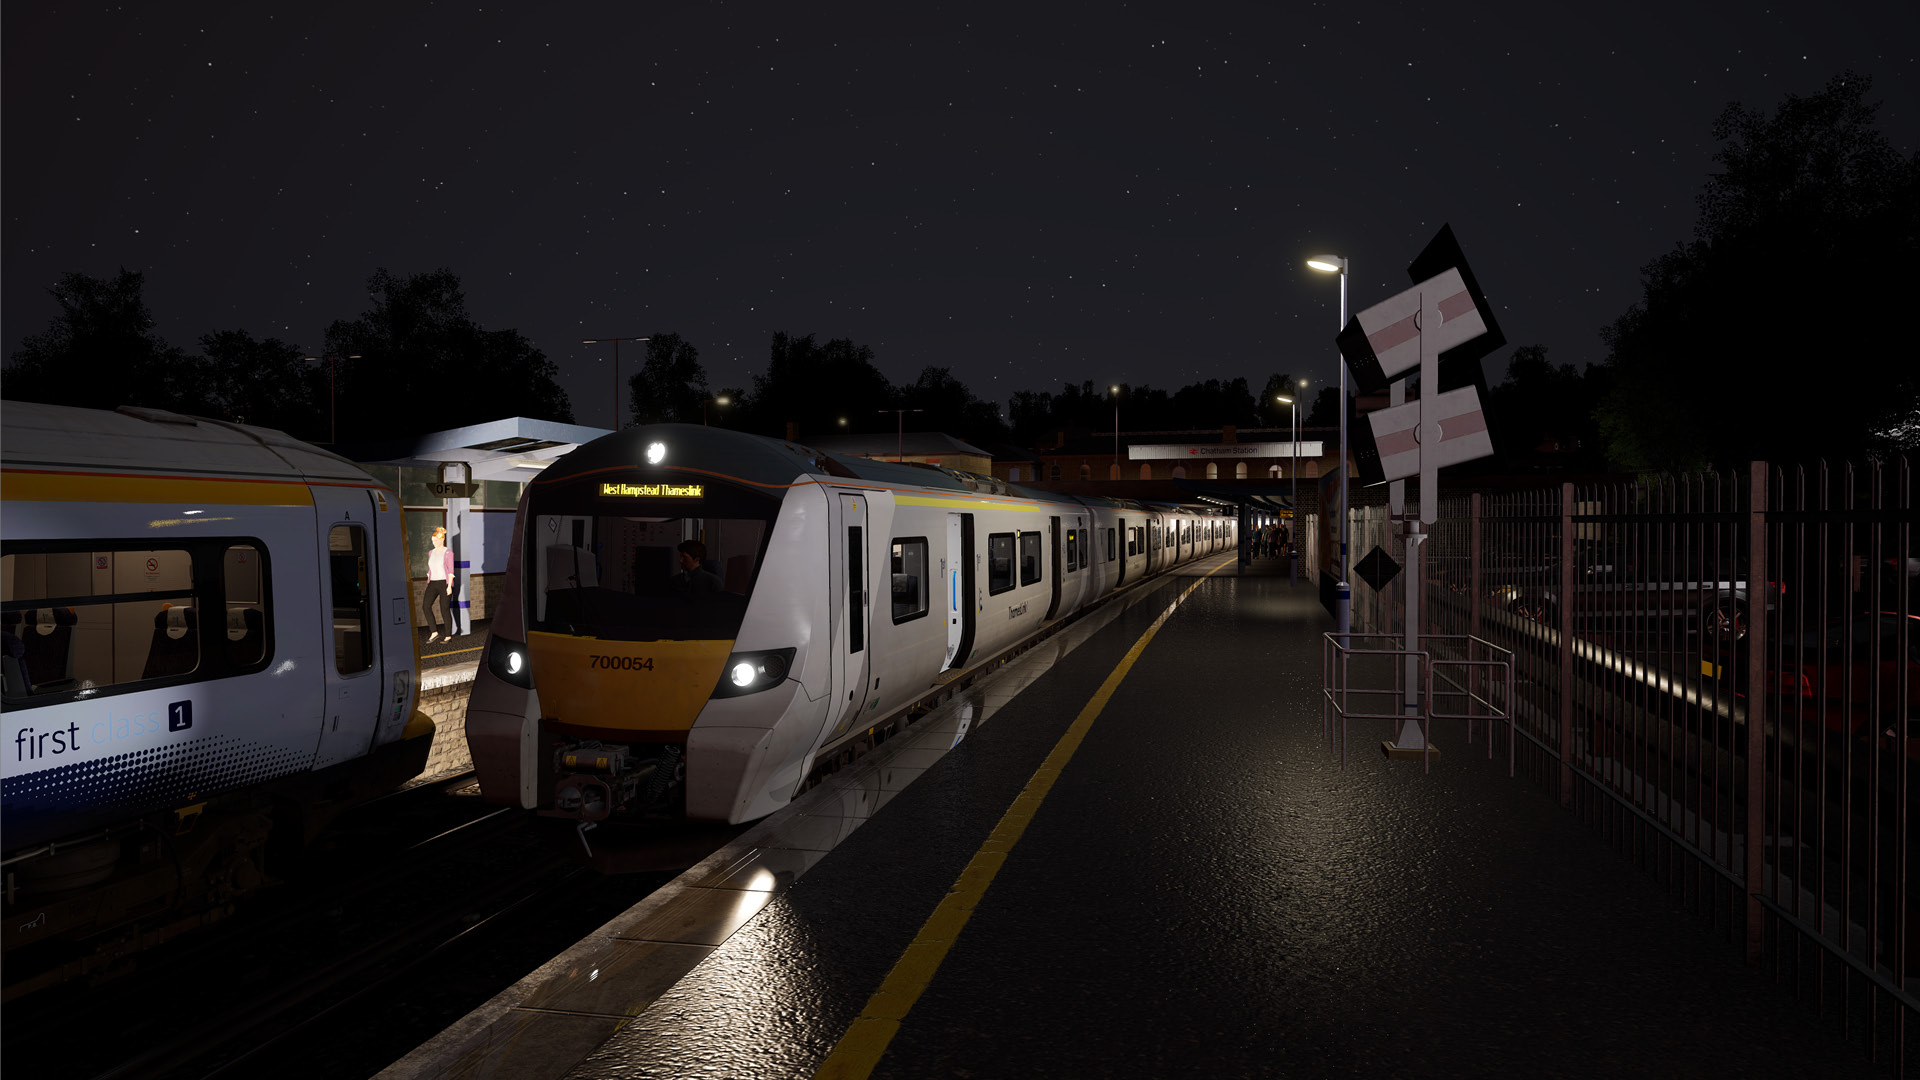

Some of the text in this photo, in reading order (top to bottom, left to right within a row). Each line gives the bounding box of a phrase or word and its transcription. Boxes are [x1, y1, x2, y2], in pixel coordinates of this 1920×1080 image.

[1200, 446, 1258, 455] Chatham Station
[603, 483, 702, 498] West Hampstead Thameslink
[589, 655, 654, 671] 700054
[15, 704, 186, 762] first class 1
